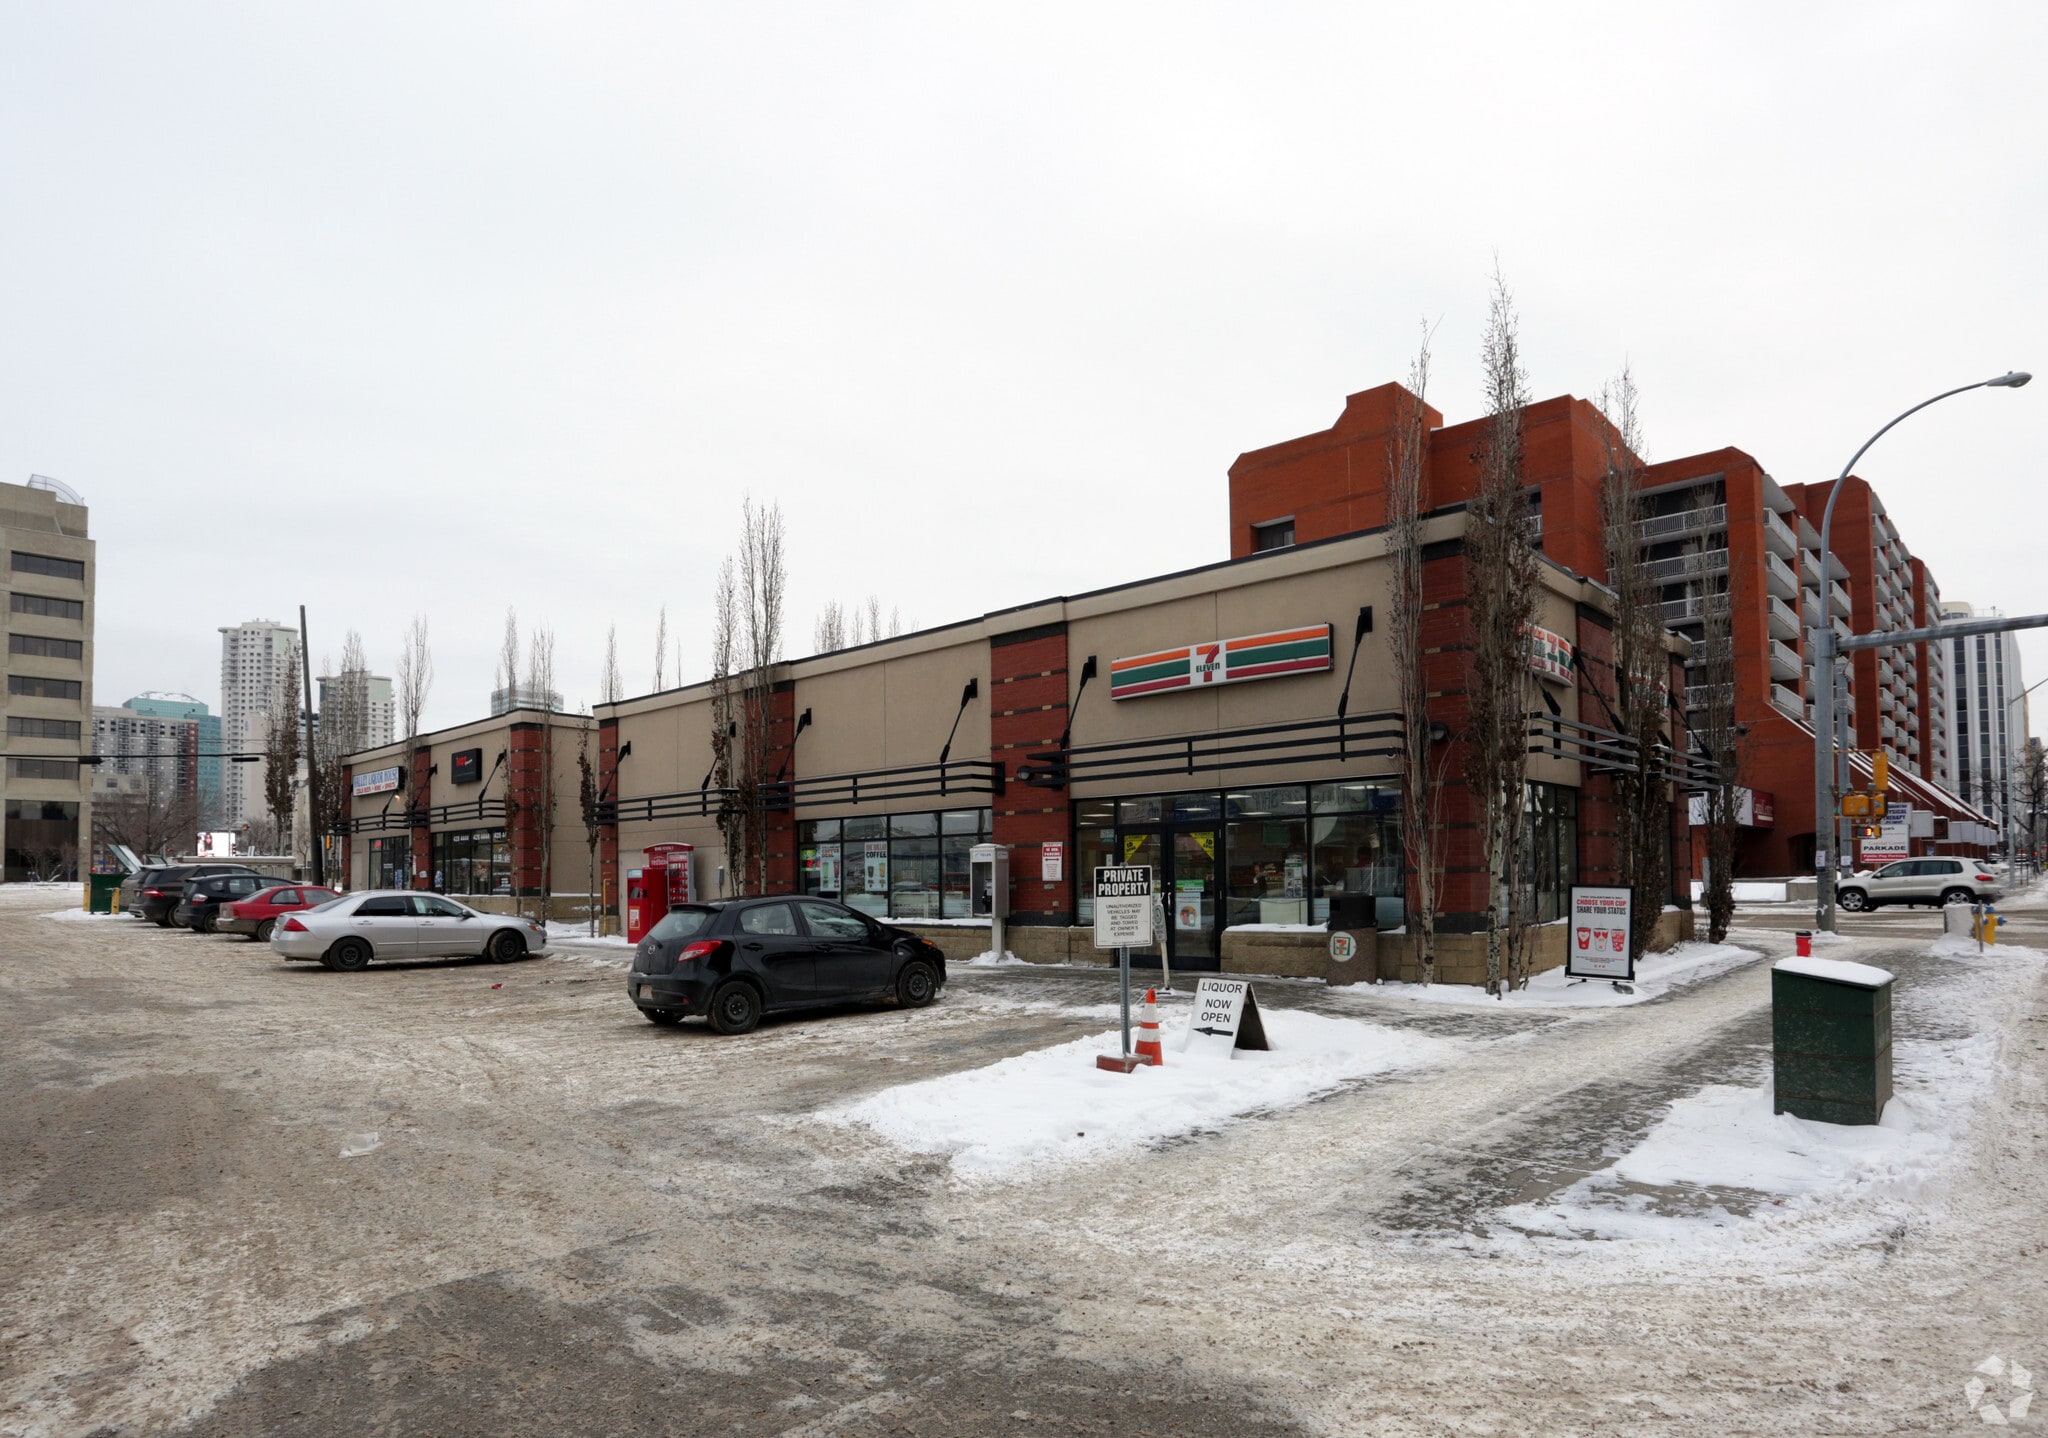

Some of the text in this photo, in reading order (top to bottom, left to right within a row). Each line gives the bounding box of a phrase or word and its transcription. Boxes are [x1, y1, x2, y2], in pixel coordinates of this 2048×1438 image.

[1197, 644, 1219, 682] 7
[1104, 870, 1143, 882] PRIVATE
[1098, 882, 1148, 896] PROPERTY
[1577, 906, 1592, 914] SHARE
[1608, 907, 1626, 915] STATUS
[1202, 982, 1242, 994] LIQUOR
[1206, 999, 1232, 1009] NOW
[1201, 1012, 1231, 1023] OPEN
